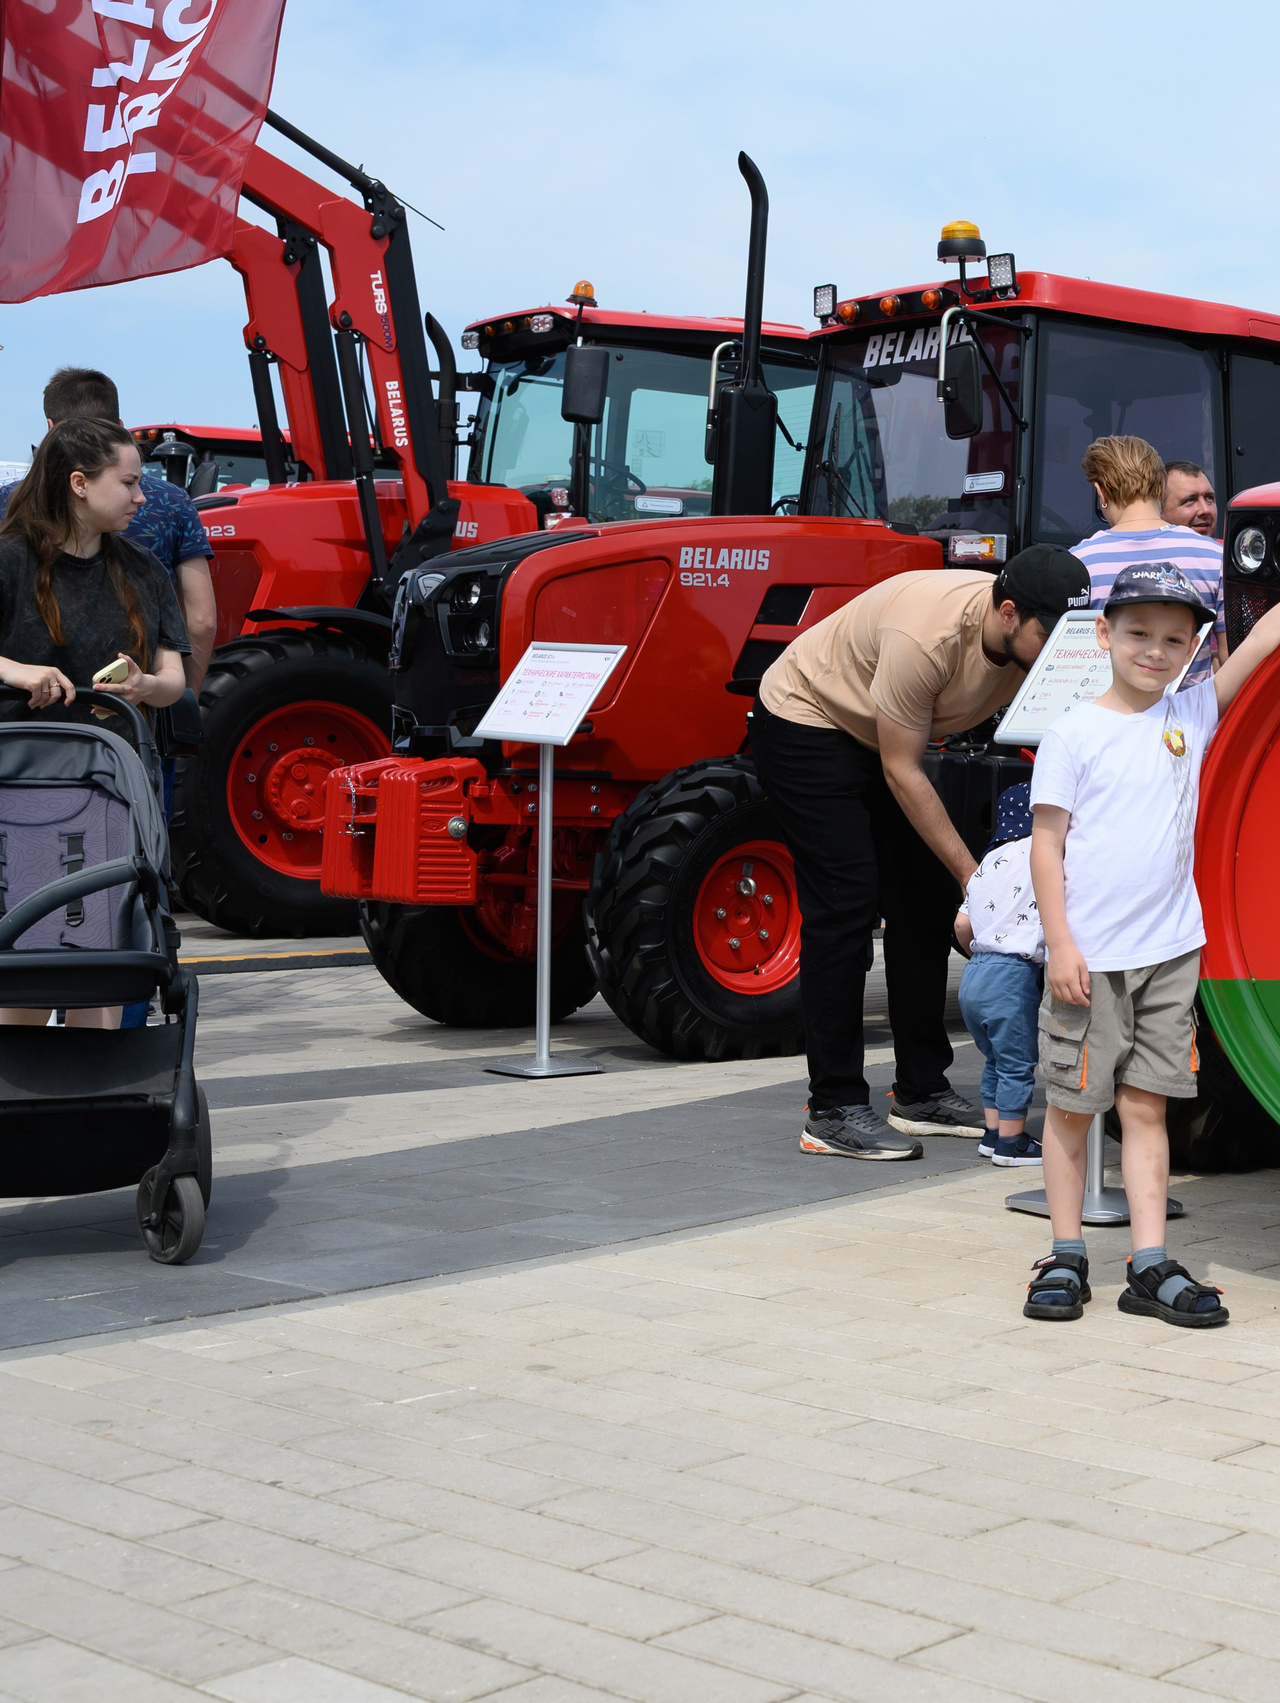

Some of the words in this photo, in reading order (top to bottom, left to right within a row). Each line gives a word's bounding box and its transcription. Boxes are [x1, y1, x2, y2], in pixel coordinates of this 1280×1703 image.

[370, 270, 388, 315] TURS
[385, 380, 409, 447] BELARUS
[679, 546, 770, 571] BELARUS
[680, 572, 730, 587] 921.4
[1065, 627, 1091, 635] BELARUS
[1053, 649, 1110, 659] ТЕХНИЧЕСКИЕ
